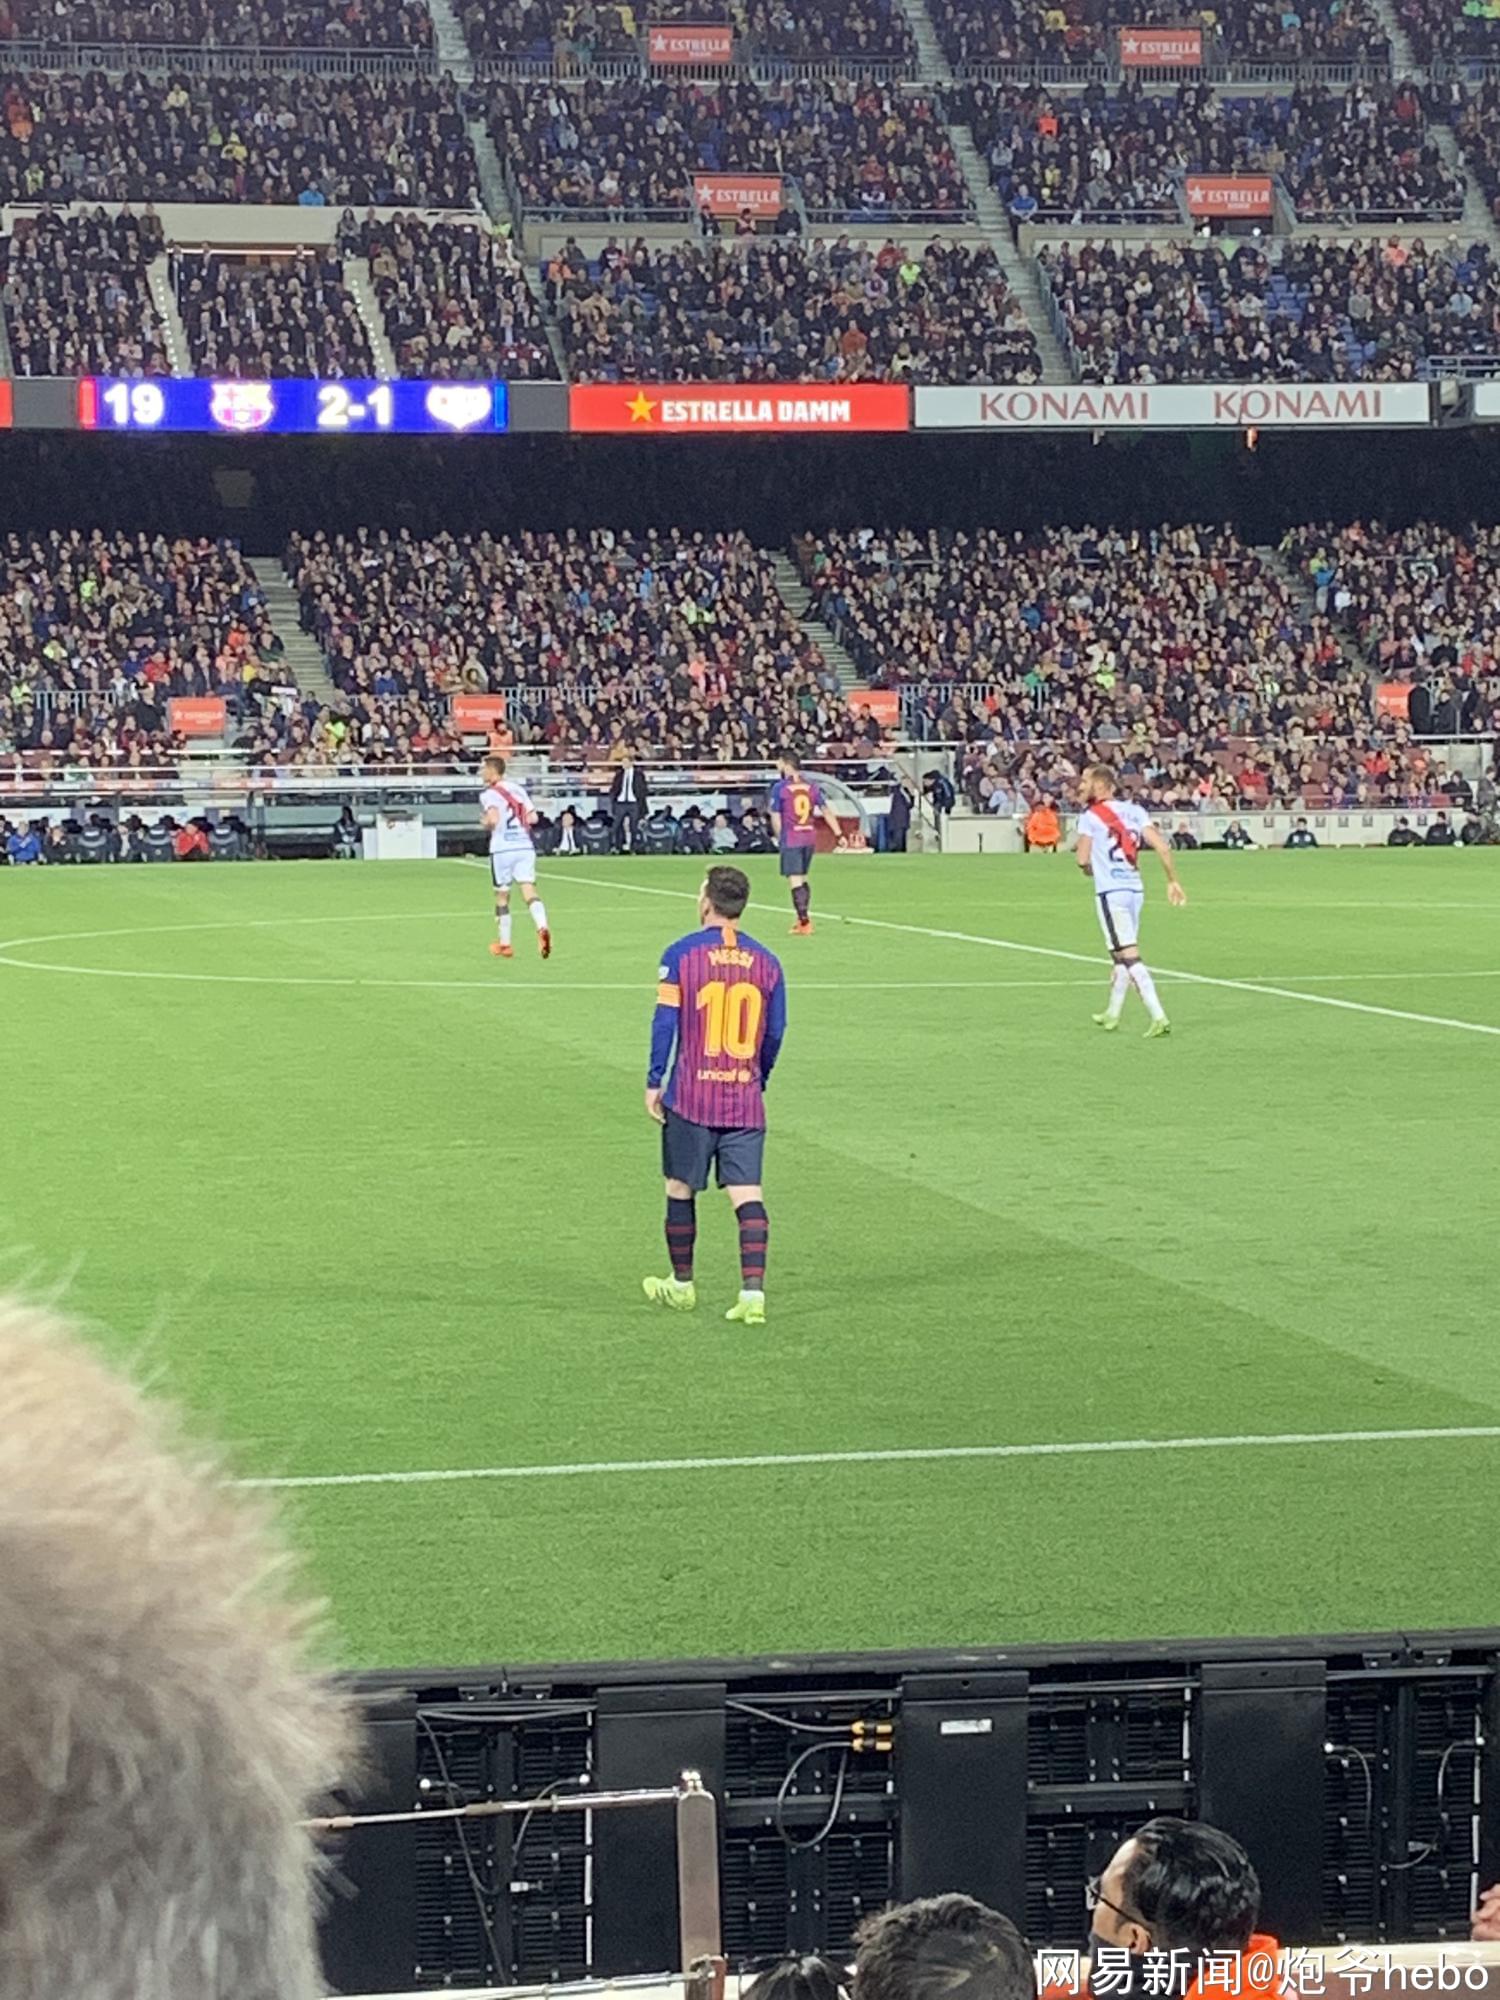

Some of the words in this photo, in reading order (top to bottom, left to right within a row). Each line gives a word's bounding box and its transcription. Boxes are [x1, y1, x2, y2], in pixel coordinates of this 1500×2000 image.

[669, 38, 730, 51] ESTRELLA
[1141, 41, 1200, 54] ESTRELLA
[716, 189, 780, 203] ESTRELLA
[1207, 189, 1270, 203] ESTRELLA
[104, 384, 164, 424] 19
[318, 384, 391, 425] 2-1
[661, 400, 771, 423] ESTRELLA
[777, 399, 851, 423] DAMM
[979, 391, 1149, 422] KONAMI
[1214, 389, 1382, 420] KONAMI
[794, 793, 811, 825] 9
[708, 949, 754, 969] MESSI
[696, 980, 762, 1060] 10
[697, 1068, 737, 1082] unicef
